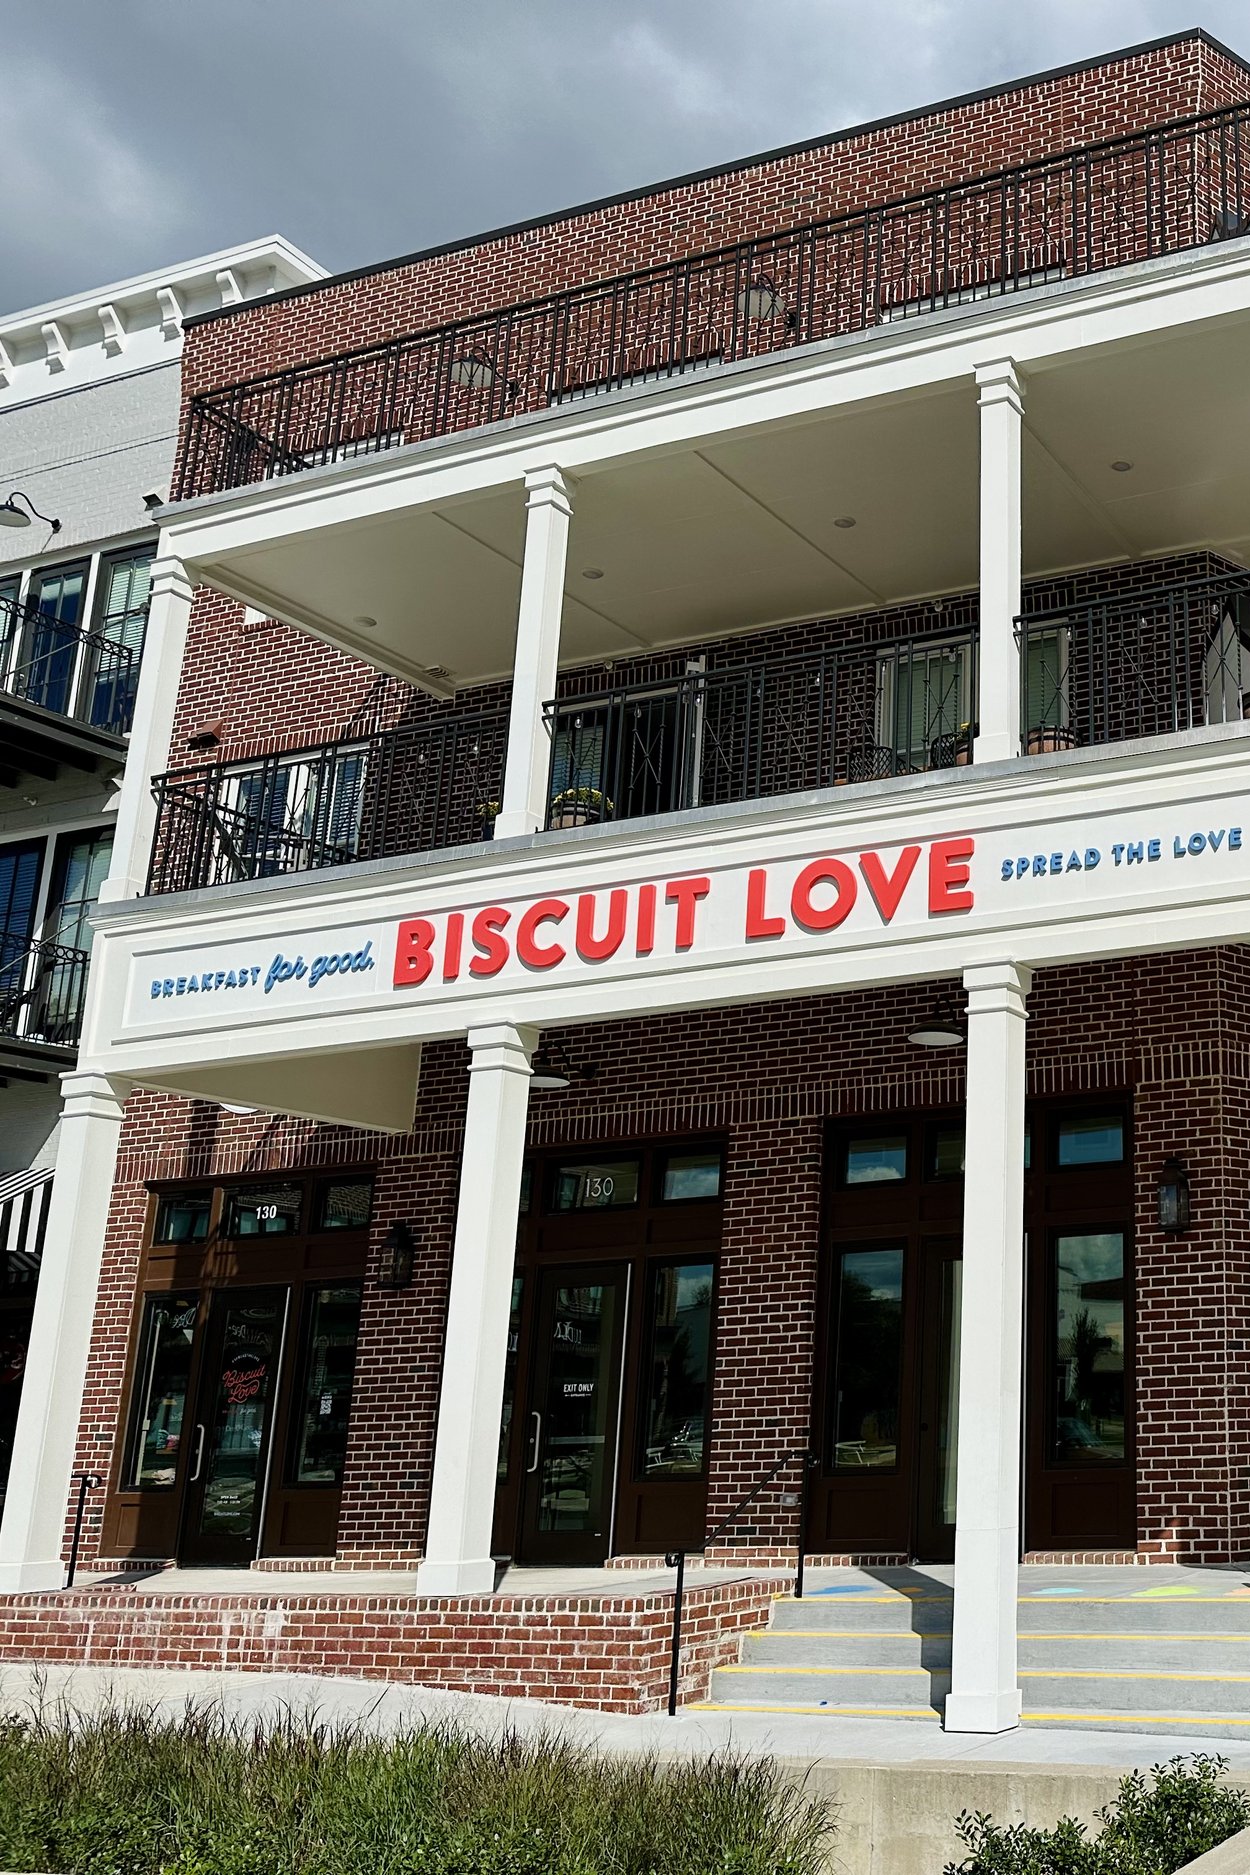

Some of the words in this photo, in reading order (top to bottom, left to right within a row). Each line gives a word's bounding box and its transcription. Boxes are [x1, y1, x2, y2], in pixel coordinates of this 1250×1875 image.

[151, 966, 262, 999] BREAKFAST
[264, 953, 309, 995] for
[393, 876, 711, 991] BISCUIT
[745, 837, 975, 943] LOVE
[1001, 847, 1102, 882] SPREAD
[1111, 838, 1162, 867] THE
[1173, 827, 1243, 859] LOVE
[586, 1177, 614, 1198] 130
[256, 1204, 277, 1220] 130
[222, 1363, 266, 1388] Biscuit
[228, 1379, 260, 1404] Love
[563, 1383, 577, 1393] EXIT
[578, 1383, 594, 1392] ONLY
